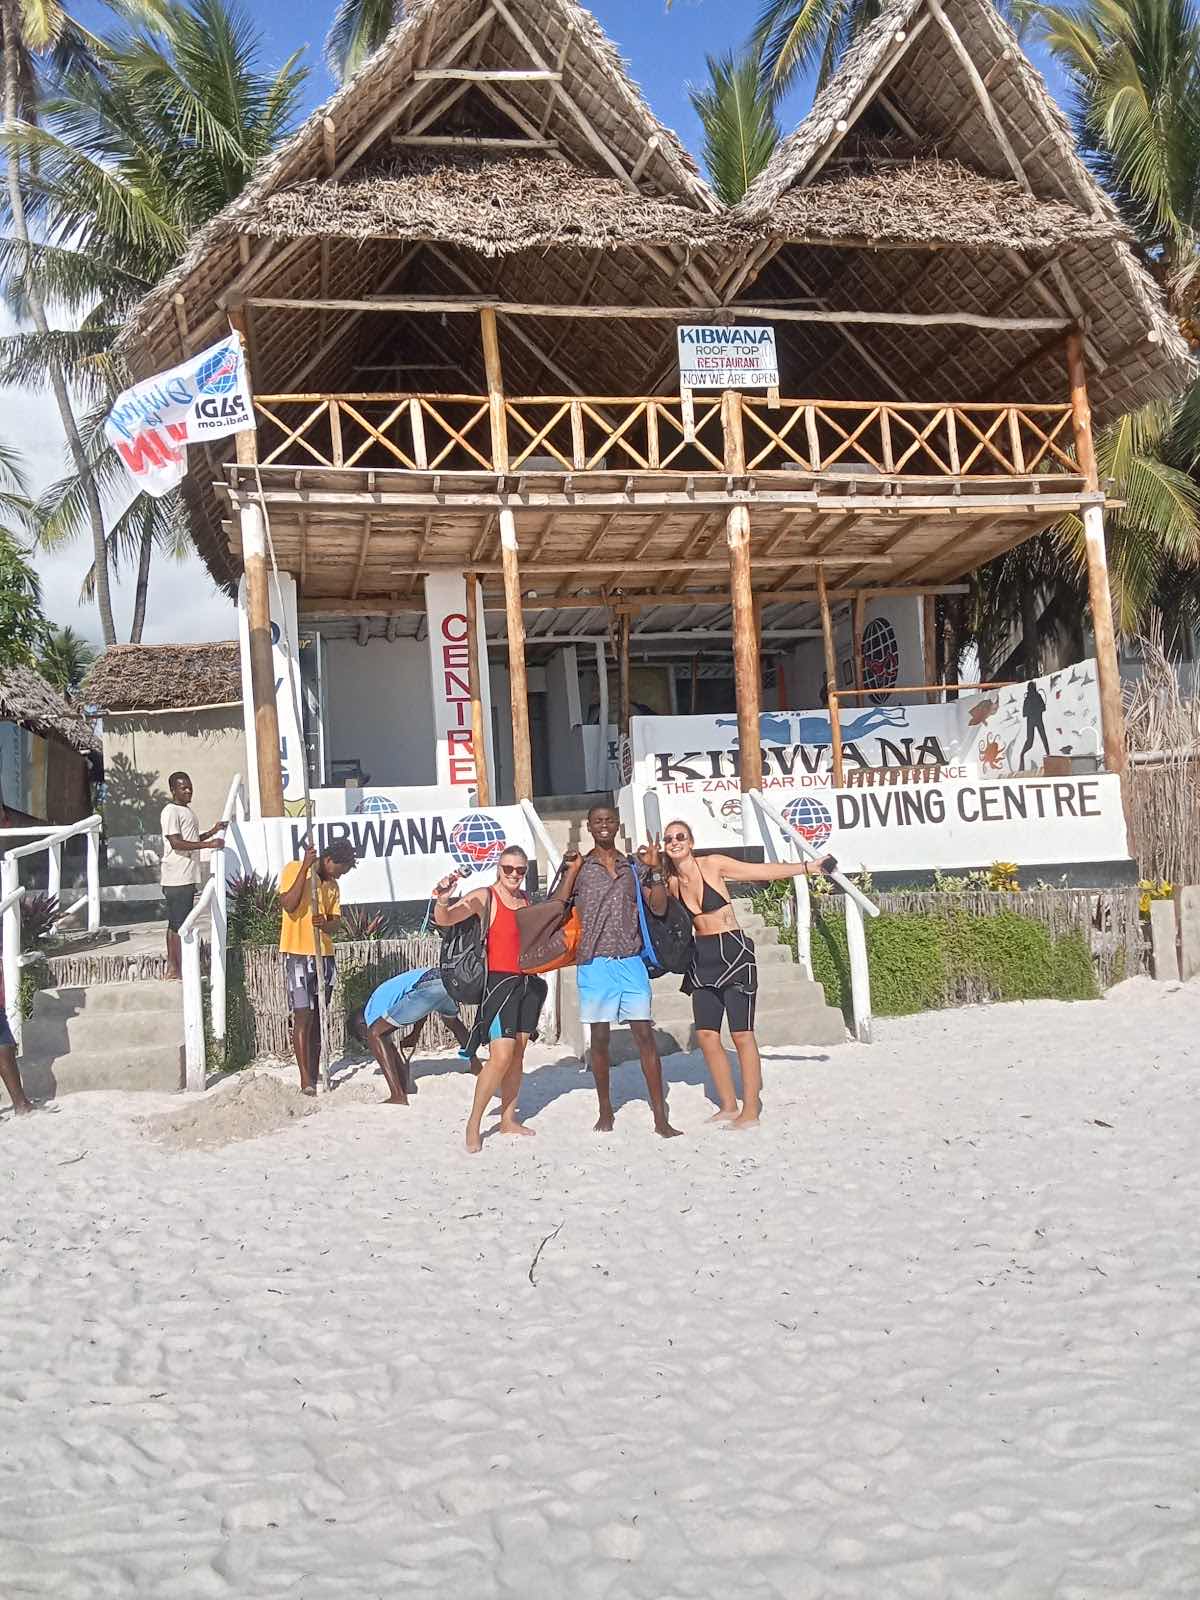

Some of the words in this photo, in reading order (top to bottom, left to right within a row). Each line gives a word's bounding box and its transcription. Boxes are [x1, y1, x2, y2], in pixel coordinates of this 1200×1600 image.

[680, 328, 773, 344] KIBWANA
[695, 346, 728, 355] ROOF
[734, 346, 760, 355] TOP
[697, 357, 760, 369] RESTAURANT
[683, 373, 707, 385] NOW
[709, 373, 725, 384] WE
[726, 373, 747, 384] ARE
[751, 372, 777, 384] OPEN
[441, 613, 478, 785] CENTRE
[663, 782, 695, 795] THE
[703, 776, 794, 793] ZANBAR
[836, 788, 946, 830] DIVING
[957, 781, 1102, 822] CENTRE
